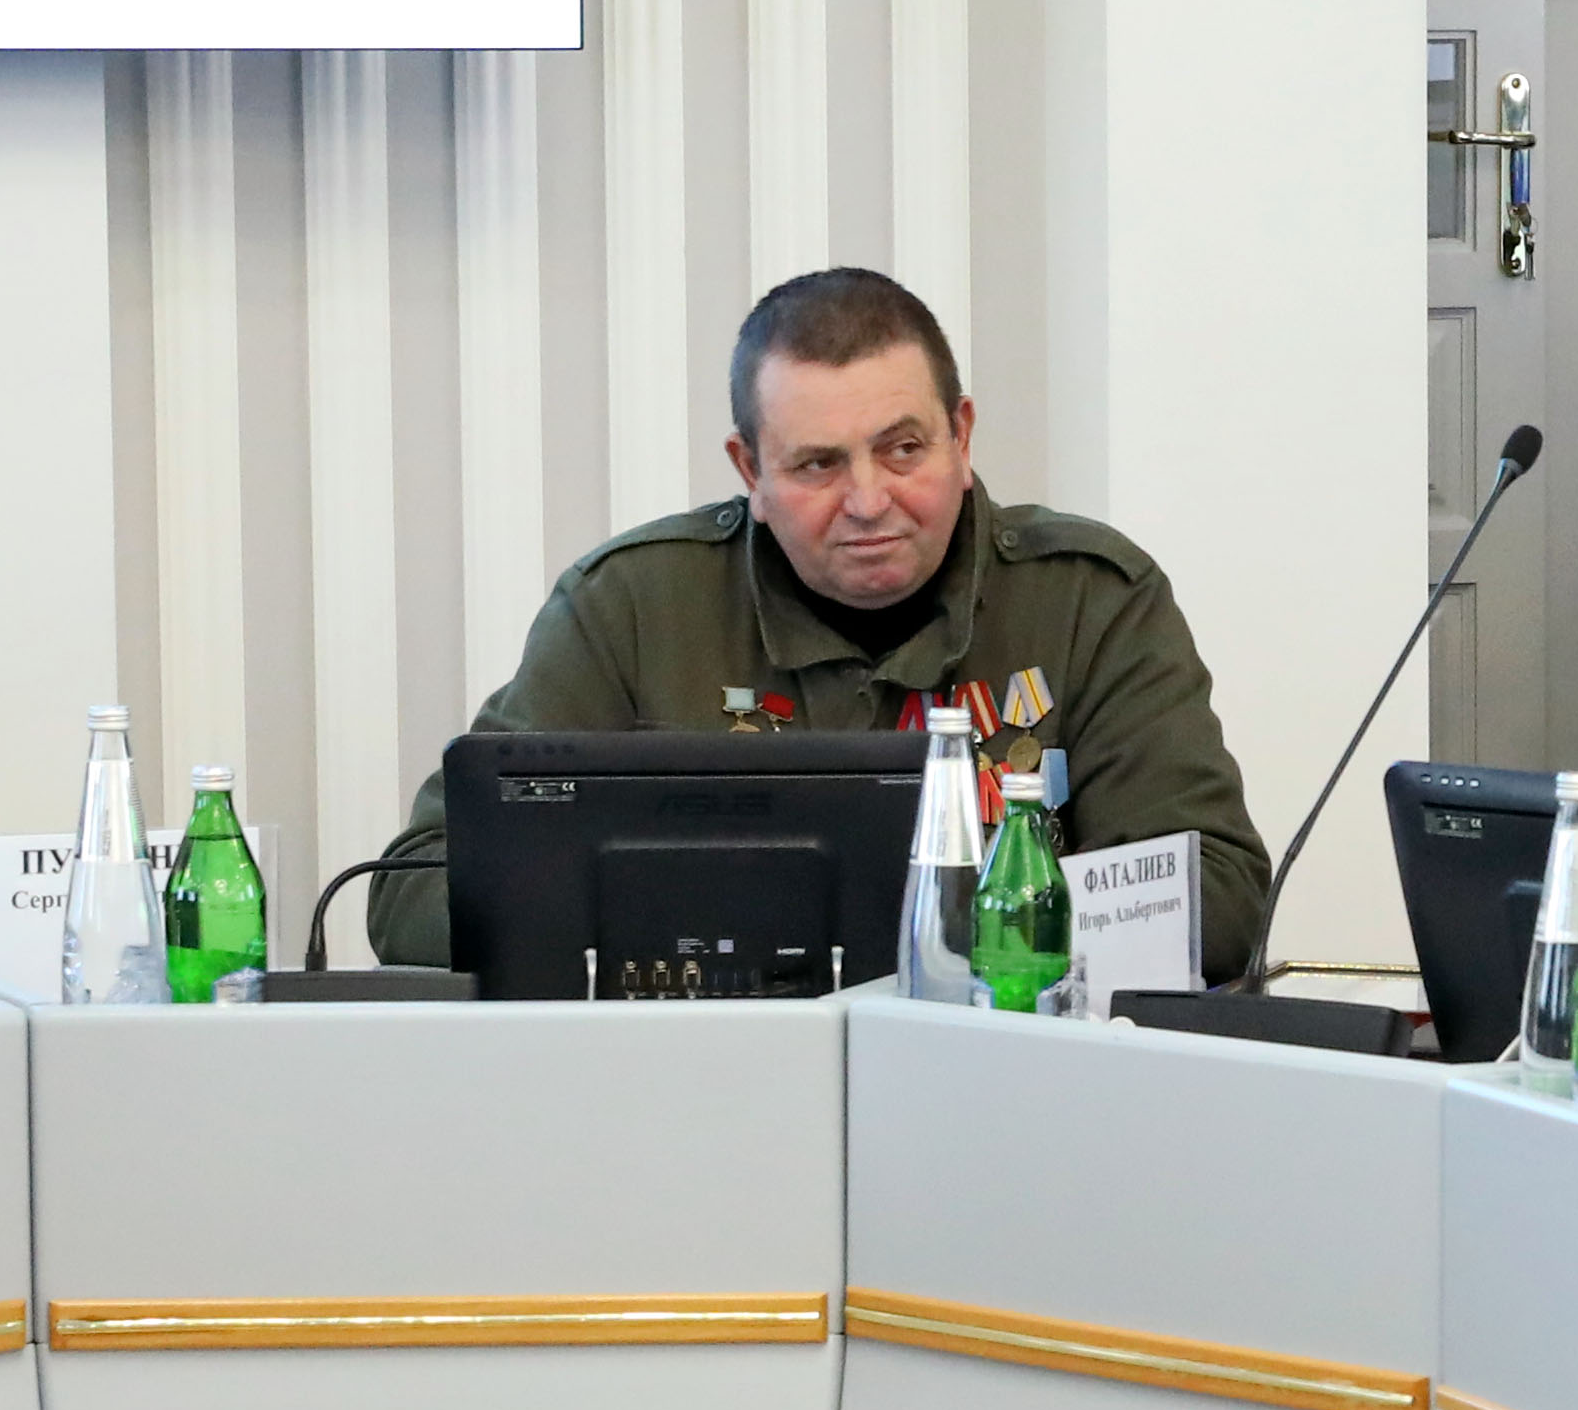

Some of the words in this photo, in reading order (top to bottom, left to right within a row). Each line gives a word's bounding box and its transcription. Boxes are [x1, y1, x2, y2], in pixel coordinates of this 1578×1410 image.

[1084, 852, 1176, 893] ФАТАЛИЕВ
[11, 890, 69, 913] Серг
[1079, 912, 1112, 932] Игорь
